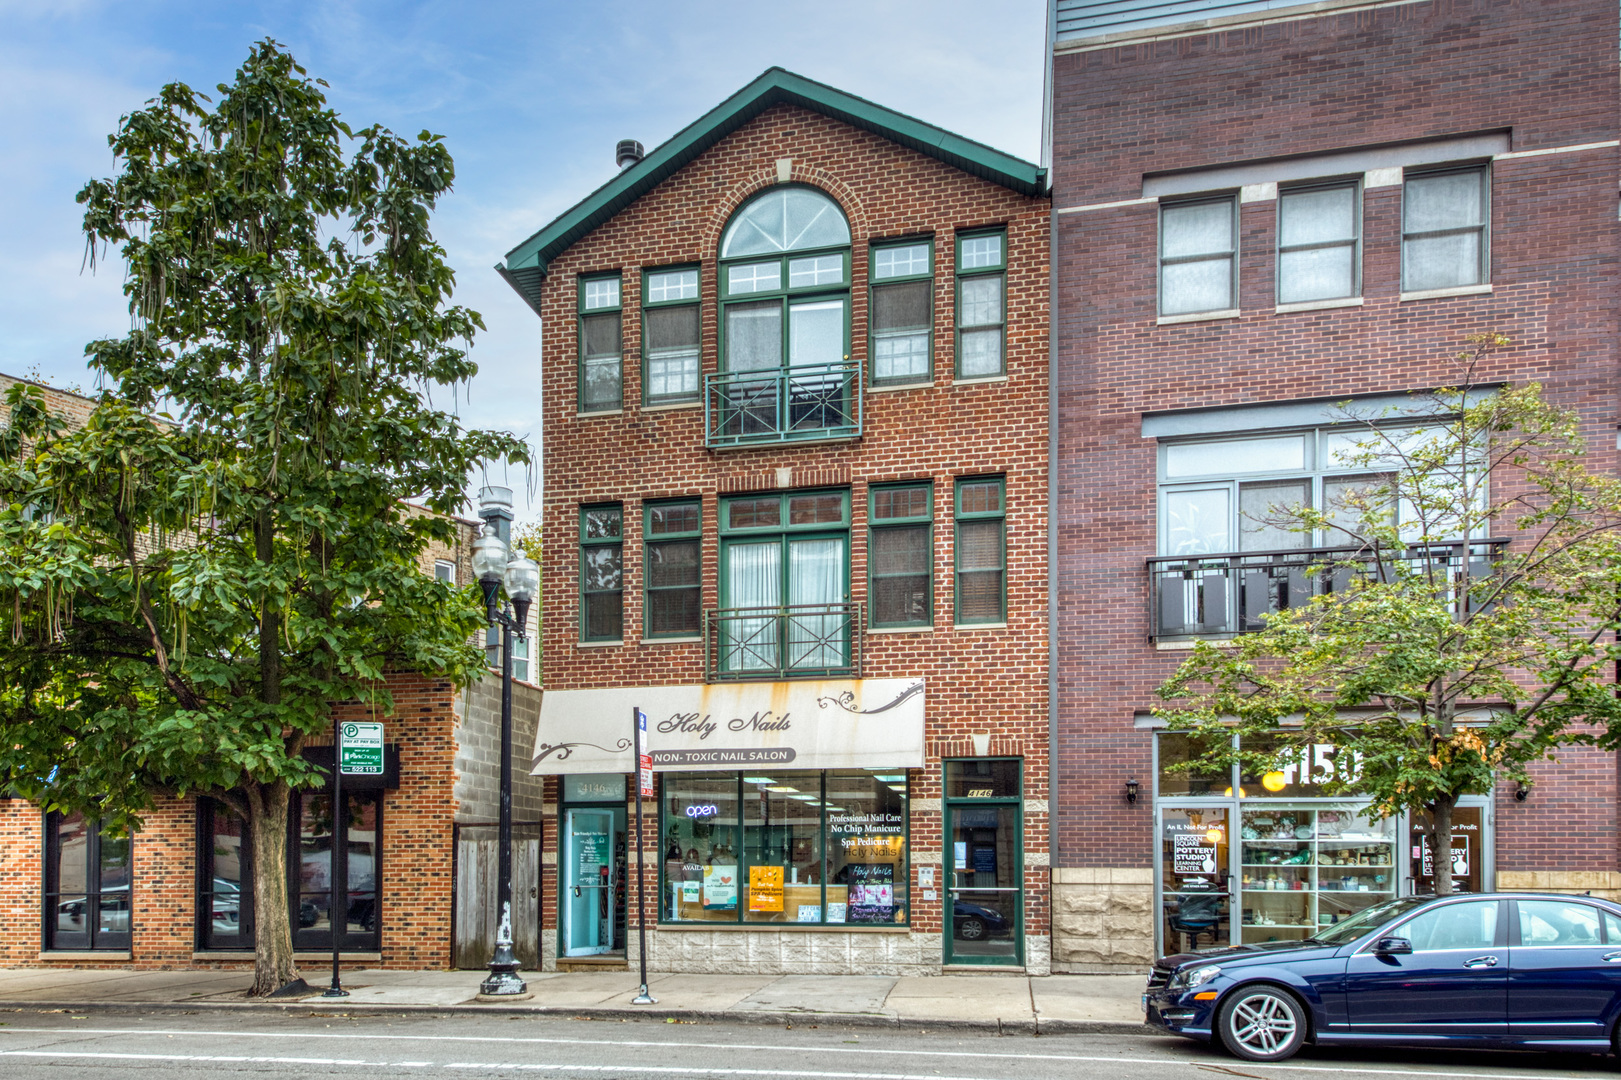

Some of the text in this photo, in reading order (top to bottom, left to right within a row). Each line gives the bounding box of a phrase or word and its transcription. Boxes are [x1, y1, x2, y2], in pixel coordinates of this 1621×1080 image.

[657, 711, 791, 740] Holy Nails
[685, 752, 718, 761] TOXIC
[720, 752, 746, 760] NAIL
[749, 751, 788, 760] SALON
[581, 783, 605, 792] 4146
[686, 805, 717, 818] open
[829, 813, 902, 823] Professional Nail Care
[831, 824, 901, 835] No Chip Manicure
[841, 837, 890, 848] Spa Pedicure
[843, 847, 897, 858] Holy Nails
[853, 865, 892, 879] Holy Nails
